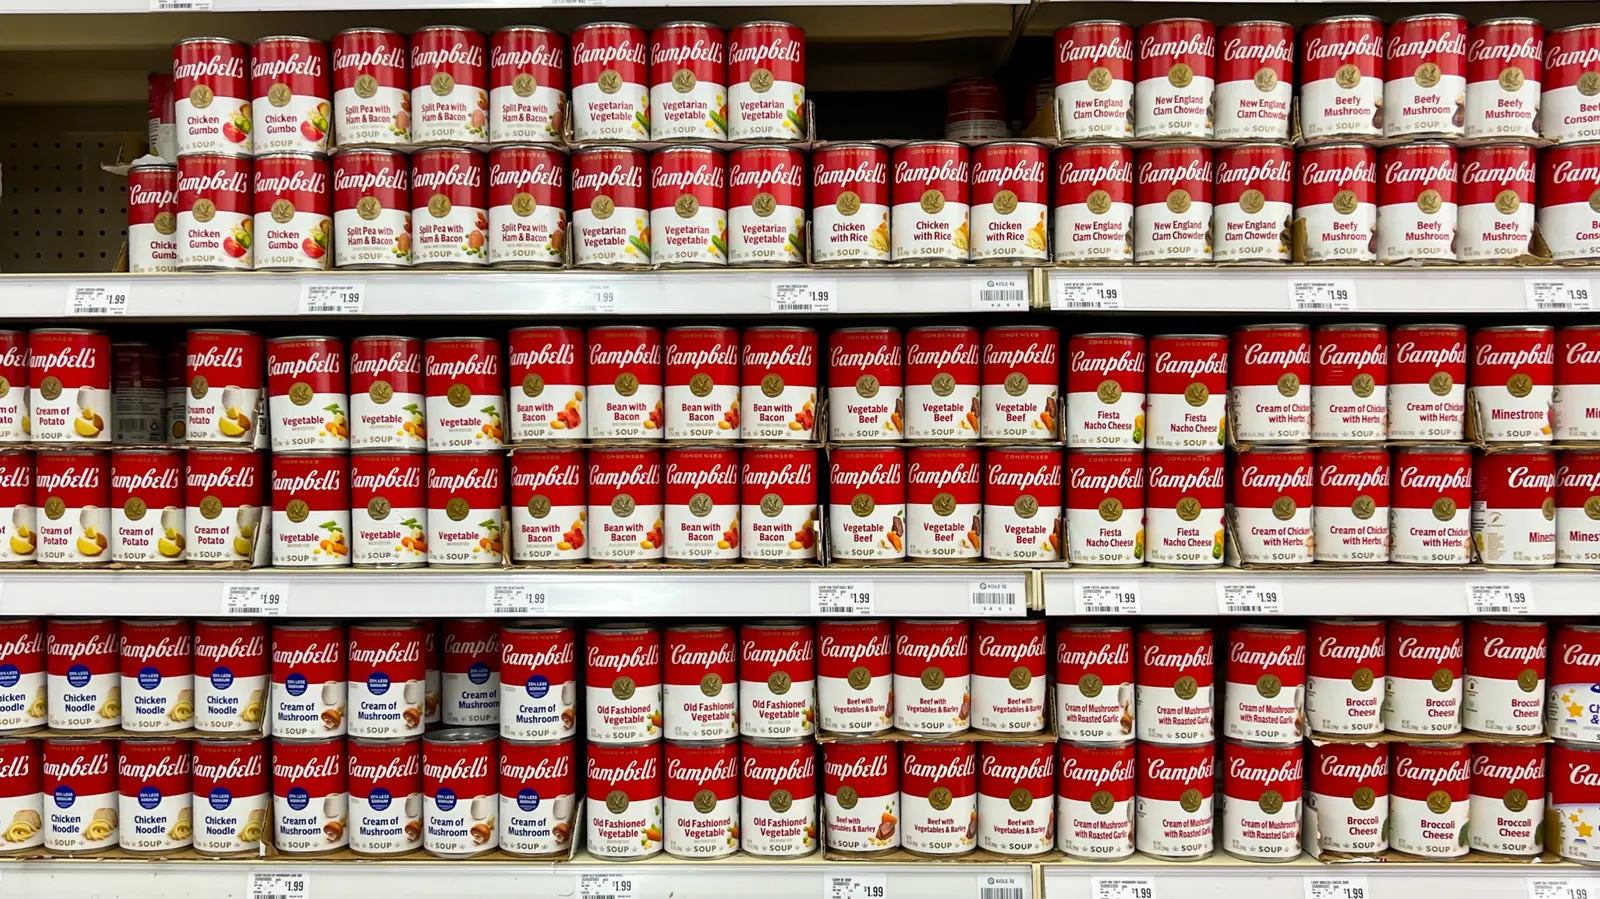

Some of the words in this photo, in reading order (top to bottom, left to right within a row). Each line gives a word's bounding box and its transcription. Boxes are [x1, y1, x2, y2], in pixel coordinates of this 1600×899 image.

[1387, 32, 1466, 59] Campbell's
[573, 40, 646, 66] Campbell's
[651, 39, 722, 65] Campbell's
[1415, 94, 1440, 104] Beefy
[663, 101, 707, 111] Vegetarian
[1403, 106, 1450, 116] Mushroom
[187, 116, 219, 125] Chicken
[665, 111, 705, 121] Vegetable
[1414, 121, 1439, 129] SOUP
[189, 126, 218, 135] Gumbo
[814, 161, 886, 187] Campbell's
[1215, 159, 1291, 185] Campbell's
[254, 170, 325, 196] Campbell's
[334, 164, 407, 192] Campbell's
[833, 223, 865, 232] Chicken
[1227, 222, 1243, 230] New
[1245, 221, 1275, 231] England
[267, 230, 299, 238] Chicken
[347, 227, 362, 236] Split
[363, 227, 376, 235] Pea
[582, 226, 626, 237] Vegetarian
[1225, 233, 1243, 241] Clam
[1245, 231, 1278, 239] Chowder
[348, 237, 363, 245] Ham
[364, 236, 370, 244] &
[371, 236, 393, 244] Bacon
[584, 237, 624, 247] Vegetable
[830, 234, 848, 242] with
[850, 233, 867, 241] Rice
[268, 241, 298, 249] Gumbo
[341, 293, 359, 302] $1.99
[809, 291, 828, 301] $1.99
[1097, 289, 1117, 298] $1.99
[1328, 290, 1347, 299] $1.99
[1567, 290, 1587, 299] $1.99
[107, 295, 125, 304] $1.99
[983, 343, 1055, 368] Campbell's
[268, 352, 340, 379] Campbell's
[36, 407, 58, 415] Cream
[61, 407, 69, 415] of
[996, 403, 1037, 413] Vegetable
[1492, 409, 1543, 419] Minestrone
[40, 417, 65, 425] Potato
[282, 416, 324, 427] Vegetable
[427, 468, 498, 493] Campbell's
[666, 464, 737, 489] Campbell's
[1149, 467, 1224, 493] Campbell's
[119, 527, 143, 535] Cream
[681, 523, 701, 531] Bean
[703, 523, 720, 531] with
[1177, 528, 1199, 536] Fiesta
[1252, 526, 1277, 535] Cream
[1277, 526, 1286, 535] of
[123, 538, 148, 546] Potato
[688, 533, 713, 541] Bacon
[1164, 538, 1186, 546] Nacho
[1188, 538, 1212, 546] Cheese
[1263, 538, 1281, 546] with
[1283, 538, 1303, 546] Herbs
[261, 594, 279, 604] $1.99
[526, 594, 544, 603] $1.99
[851, 593, 869, 603] $1.99
[1116, 593, 1135, 603] $1.99
[1257, 592, 1276, 602] $1.99
[1505, 593, 1525, 602] $1.99
[121, 635, 191, 662] Campbell's
[896, 636, 968, 662] Campbell's
[502, 644, 574, 670] Campbell's
[1057, 643, 1129, 669] Campbell's
[135, 696, 166, 704] Chicken
[1346, 698, 1376, 706] Broccoli
[136, 706, 165, 714] Noodle
[519, 704, 547, 714] Cream
[547, 704, 556, 714] of
[907, 705, 937, 713] Vegetables
[1065, 703, 1081, 712] Cream
[1082, 704, 1088, 712] of
[1089, 704, 1120, 712] Mushroom
[1348, 708, 1375, 716] Cheese
[516, 715, 559, 723] Mushroom
[1067, 714, 1077, 722] with
[1078, 714, 1101, 723] Roasted
[1103, 715, 1118, 723] Garlic
[349, 756, 419, 783] Campbell's
[587, 756, 656, 786] Campbell's
[593, 818, 603, 827] Old
[605, 819, 645, 828] Fashioned
[1421, 820, 1455, 829] Broccoli
[599, 828, 638, 839] Vegetable
[1423, 830, 1453, 839] Cheese
[285, 881, 303, 891] $1.99
[613, 881, 631, 891] $1.99
[864, 886, 883, 897] $1.99
[1132, 888, 1151, 898] $1.99
[1344, 888, 1363, 898] $1.99
[1567, 889, 1587, 899] $1.99
